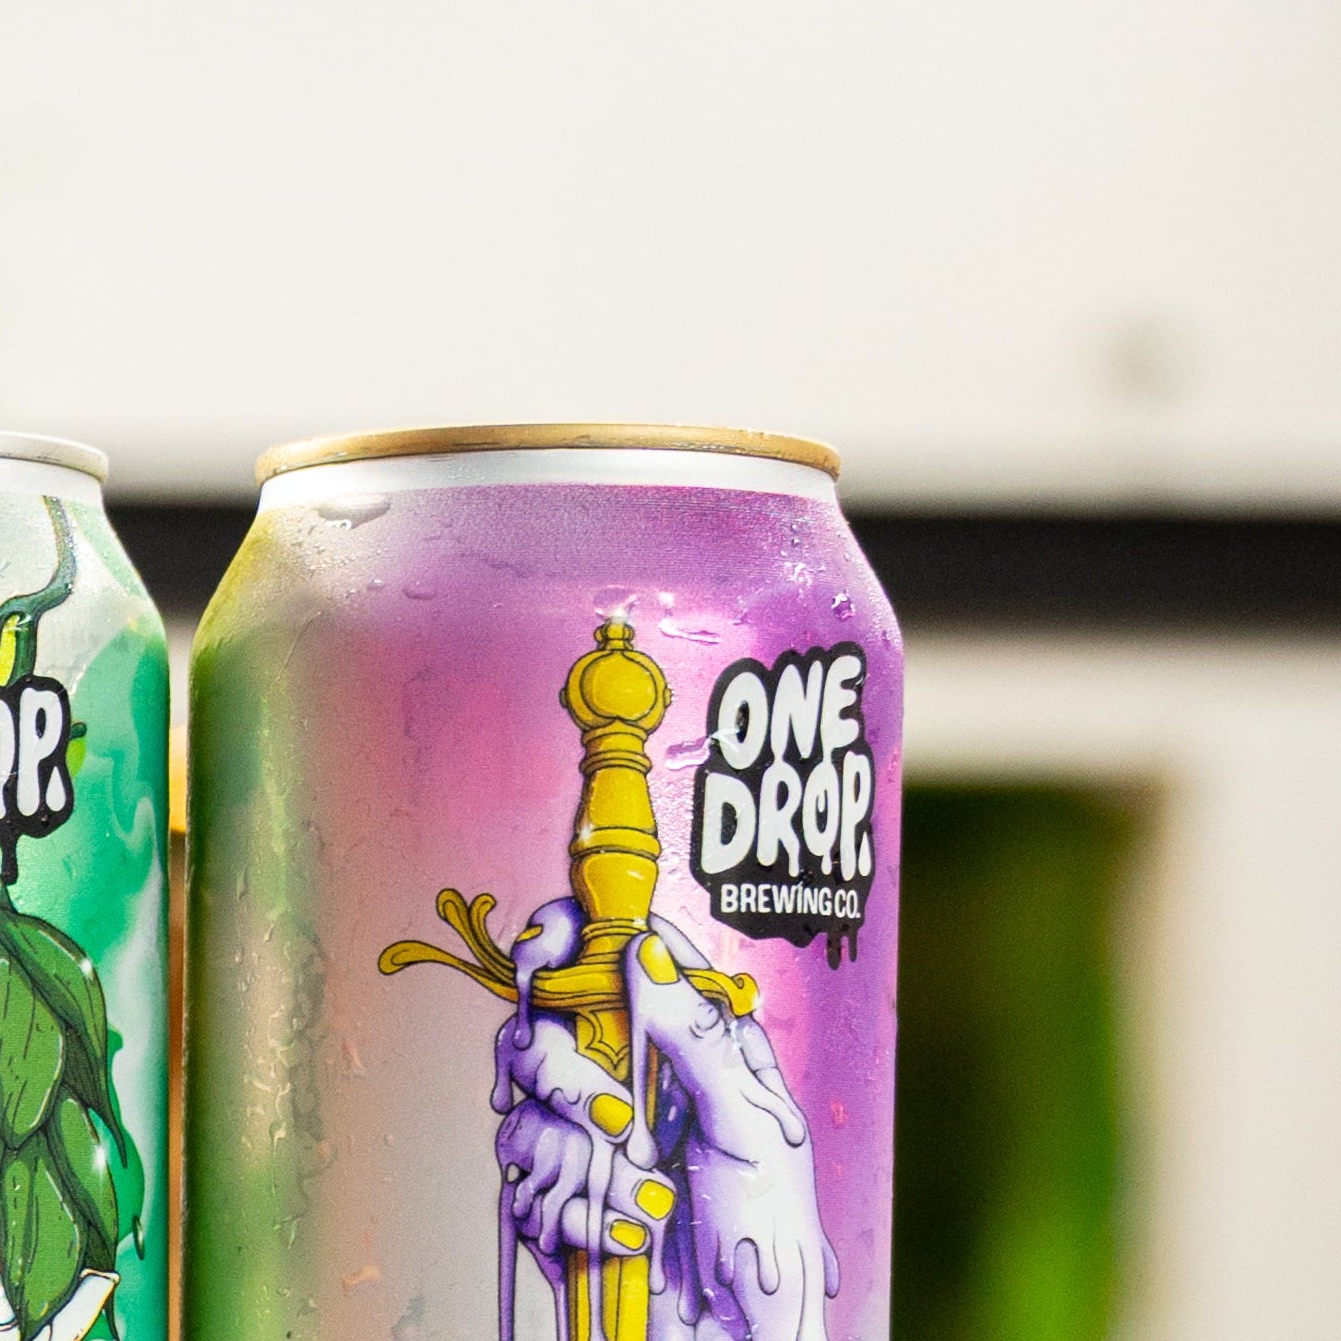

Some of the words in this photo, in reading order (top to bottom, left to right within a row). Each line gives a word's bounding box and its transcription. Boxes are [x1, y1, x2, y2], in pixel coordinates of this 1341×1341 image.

[717, 655, 863, 770] ONE
[721, 883, 832, 915] BREWING
[835, 889, 861, 920] CO.
